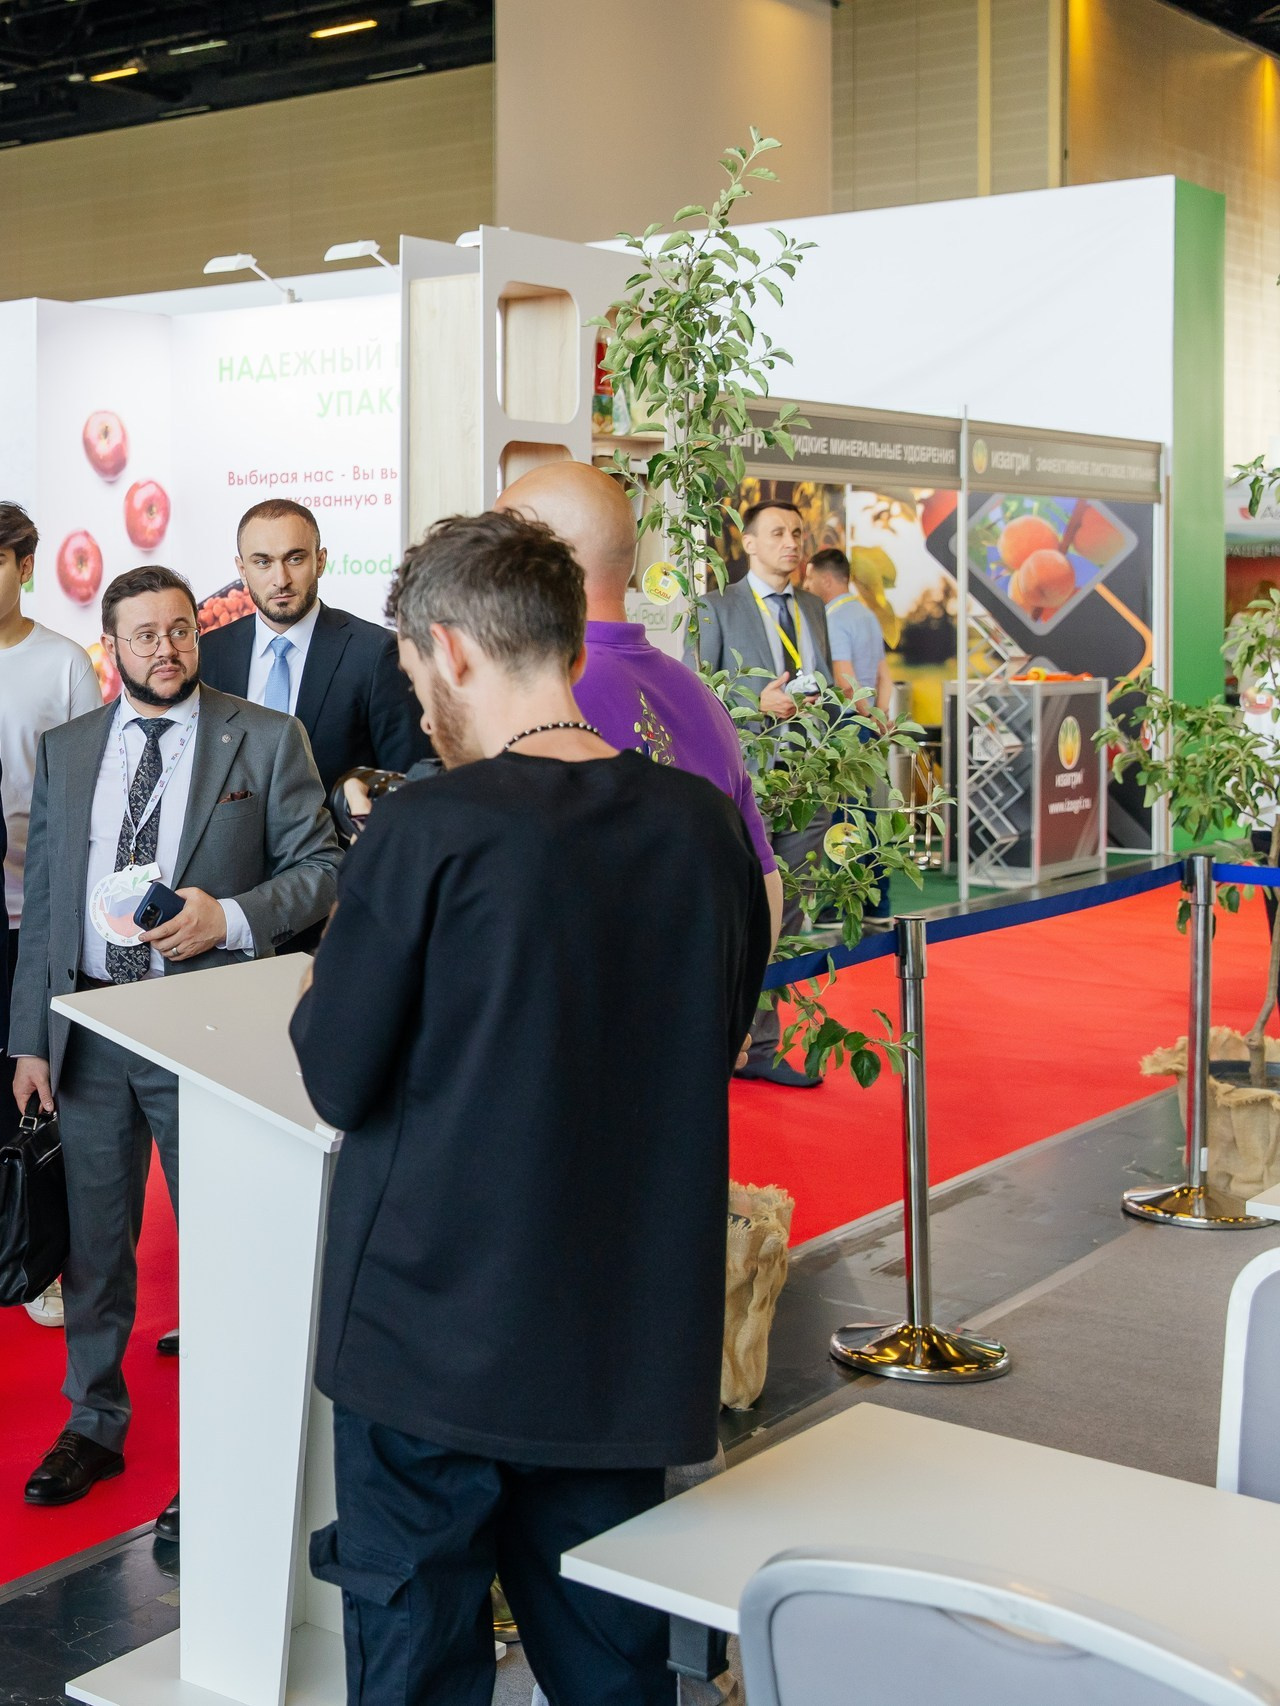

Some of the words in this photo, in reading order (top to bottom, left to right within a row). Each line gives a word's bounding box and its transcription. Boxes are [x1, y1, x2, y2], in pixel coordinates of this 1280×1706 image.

[218, 337, 382, 383] НАДЕЖНЫЙ
[316, 386, 401, 418] УПАК
[792, 434, 829, 456] ИДКИЕ
[829, 437, 902, 460] МИНЕРАЛЬНЫЕ
[903, 446, 956, 465] УДОБРЕНИЯ
[228, 469, 298, 488] Выбирая
[304, 469, 334, 483] нас
[352, 465, 374, 481] Вы
